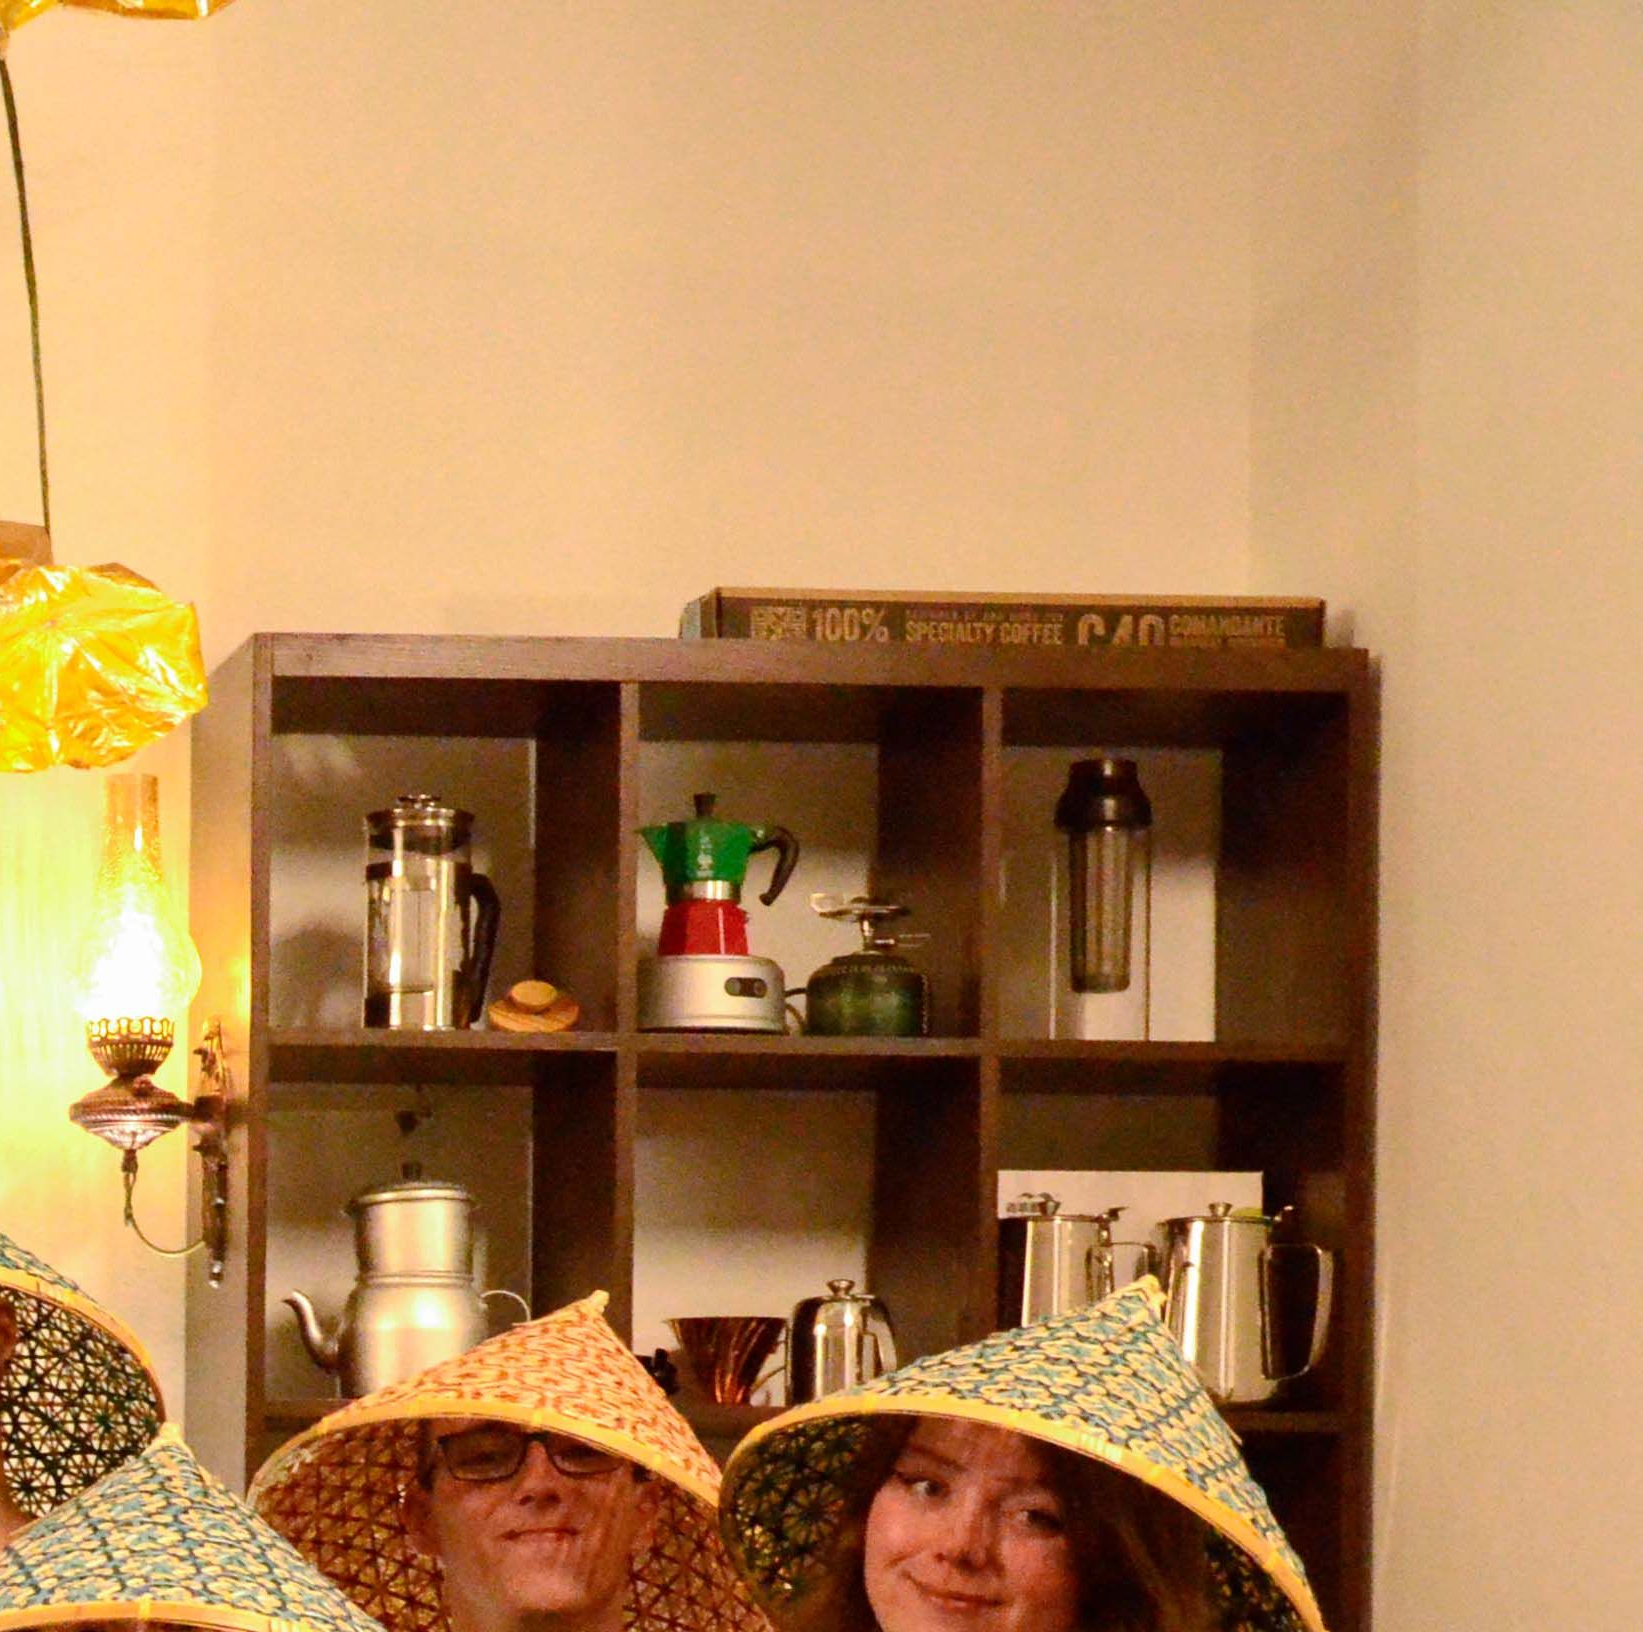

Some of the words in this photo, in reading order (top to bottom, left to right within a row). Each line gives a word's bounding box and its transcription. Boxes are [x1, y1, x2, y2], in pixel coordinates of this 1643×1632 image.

[812, 607, 889, 641] 100%
[905, 621, 993, 644] SPECIALTY
[999, 623, 1064, 646] COFFEE
